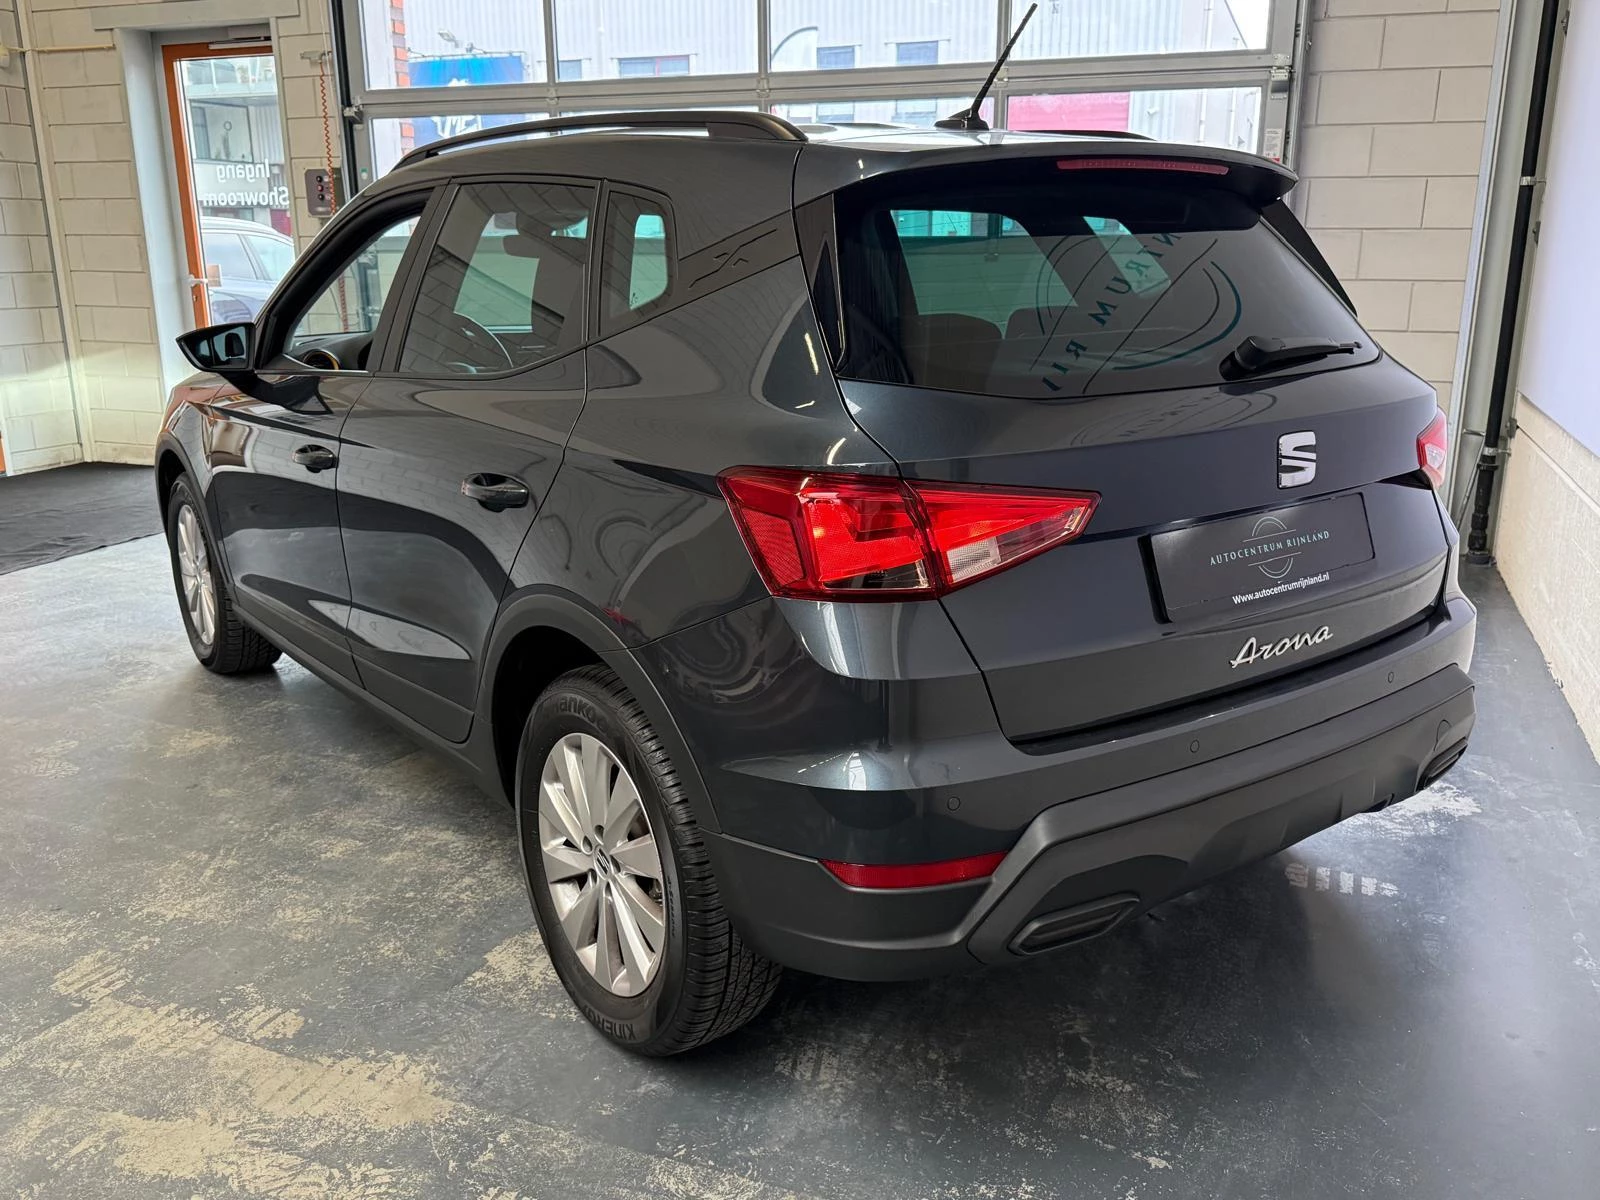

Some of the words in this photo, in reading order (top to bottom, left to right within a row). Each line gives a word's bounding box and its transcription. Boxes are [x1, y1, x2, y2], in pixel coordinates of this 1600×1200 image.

[1209, 541, 1284, 567] AUTOCENTRUM
[1286, 529, 1331, 550] RIJNLAND
[1229, 625, 1334, 669] Arona
